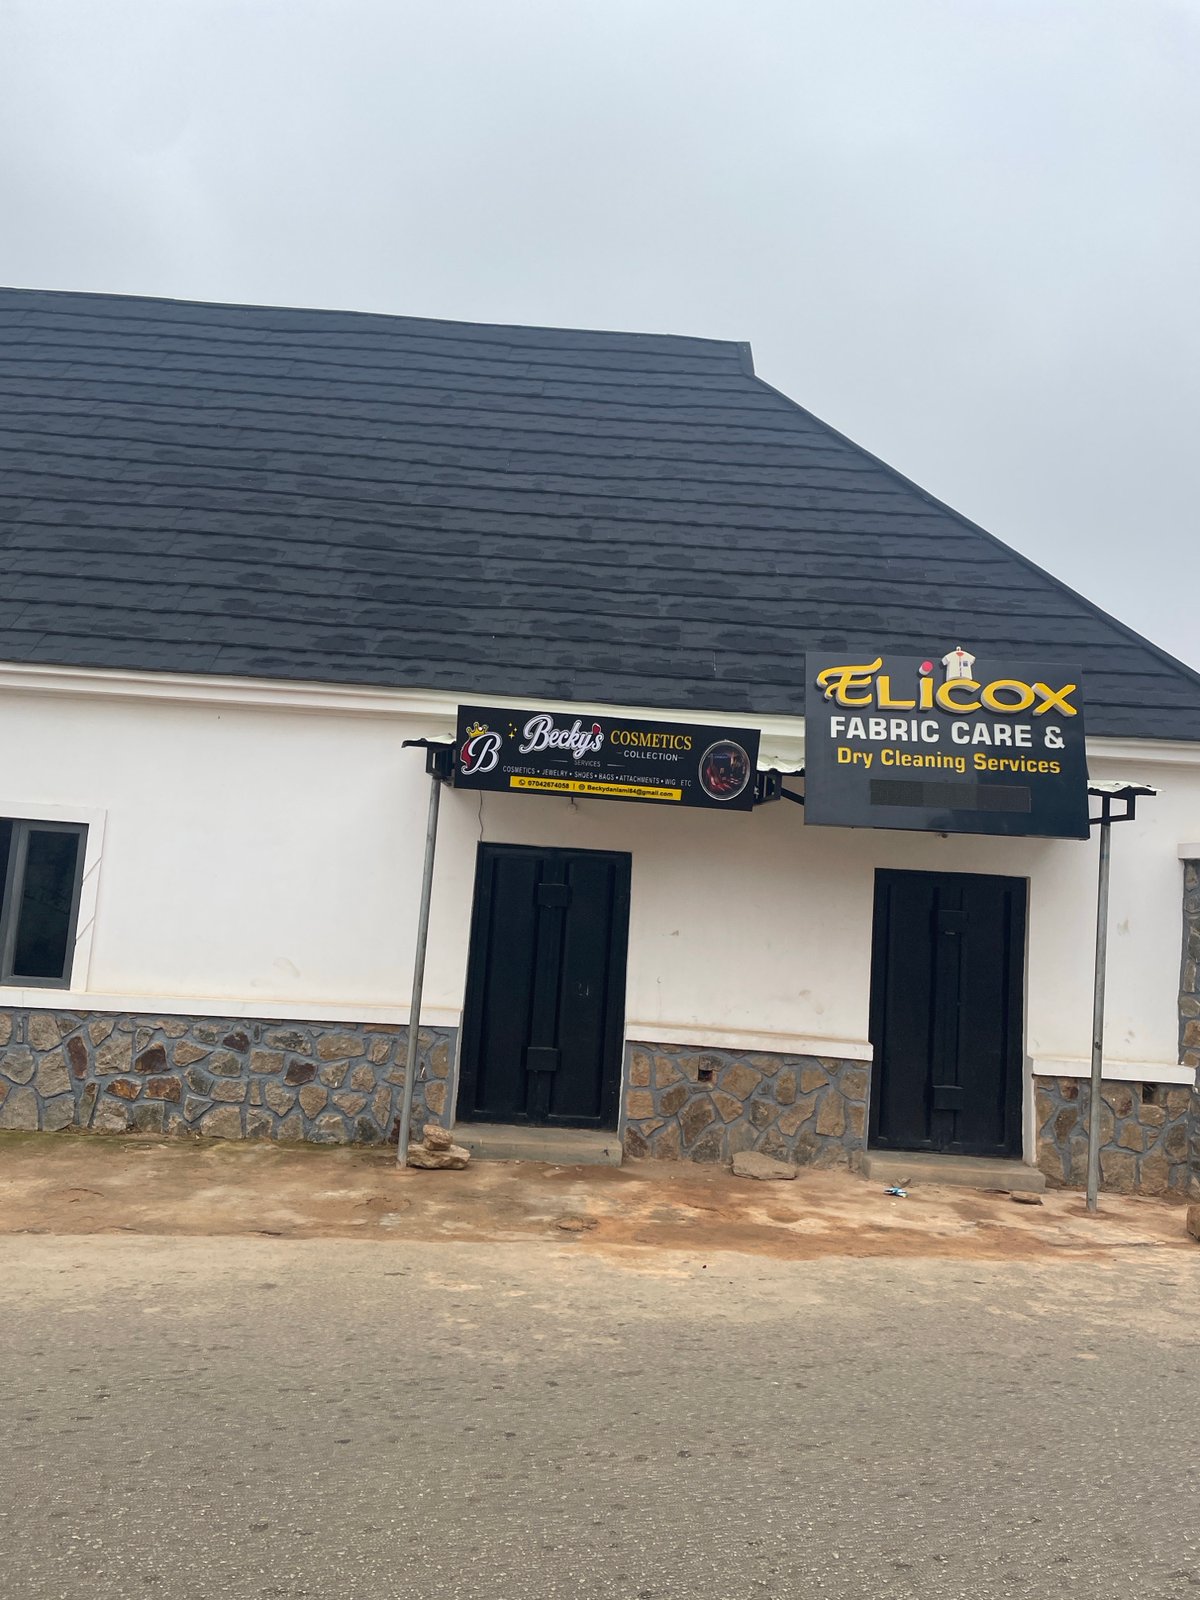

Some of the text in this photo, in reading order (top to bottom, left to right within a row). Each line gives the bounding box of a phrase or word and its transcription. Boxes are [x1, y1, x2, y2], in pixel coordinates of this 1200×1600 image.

[519, 714, 692, 759] Becky's COSMETICS
[830, 716, 1065, 749] FABRIC CARE &
[461, 732, 503, 775] B
[623, 750, 678, 761] COLLECTION
[837, 747, 1061, 774] Dry Cleaning Services
[503, 766, 535, 774] COSMETICS
[542, 769, 568, 777] JEWELRY
[574, 771, 593, 779] SHOES
[620, 774, 660, 784] ATTACHMENTS
[680, 778, 692, 787] ETC
